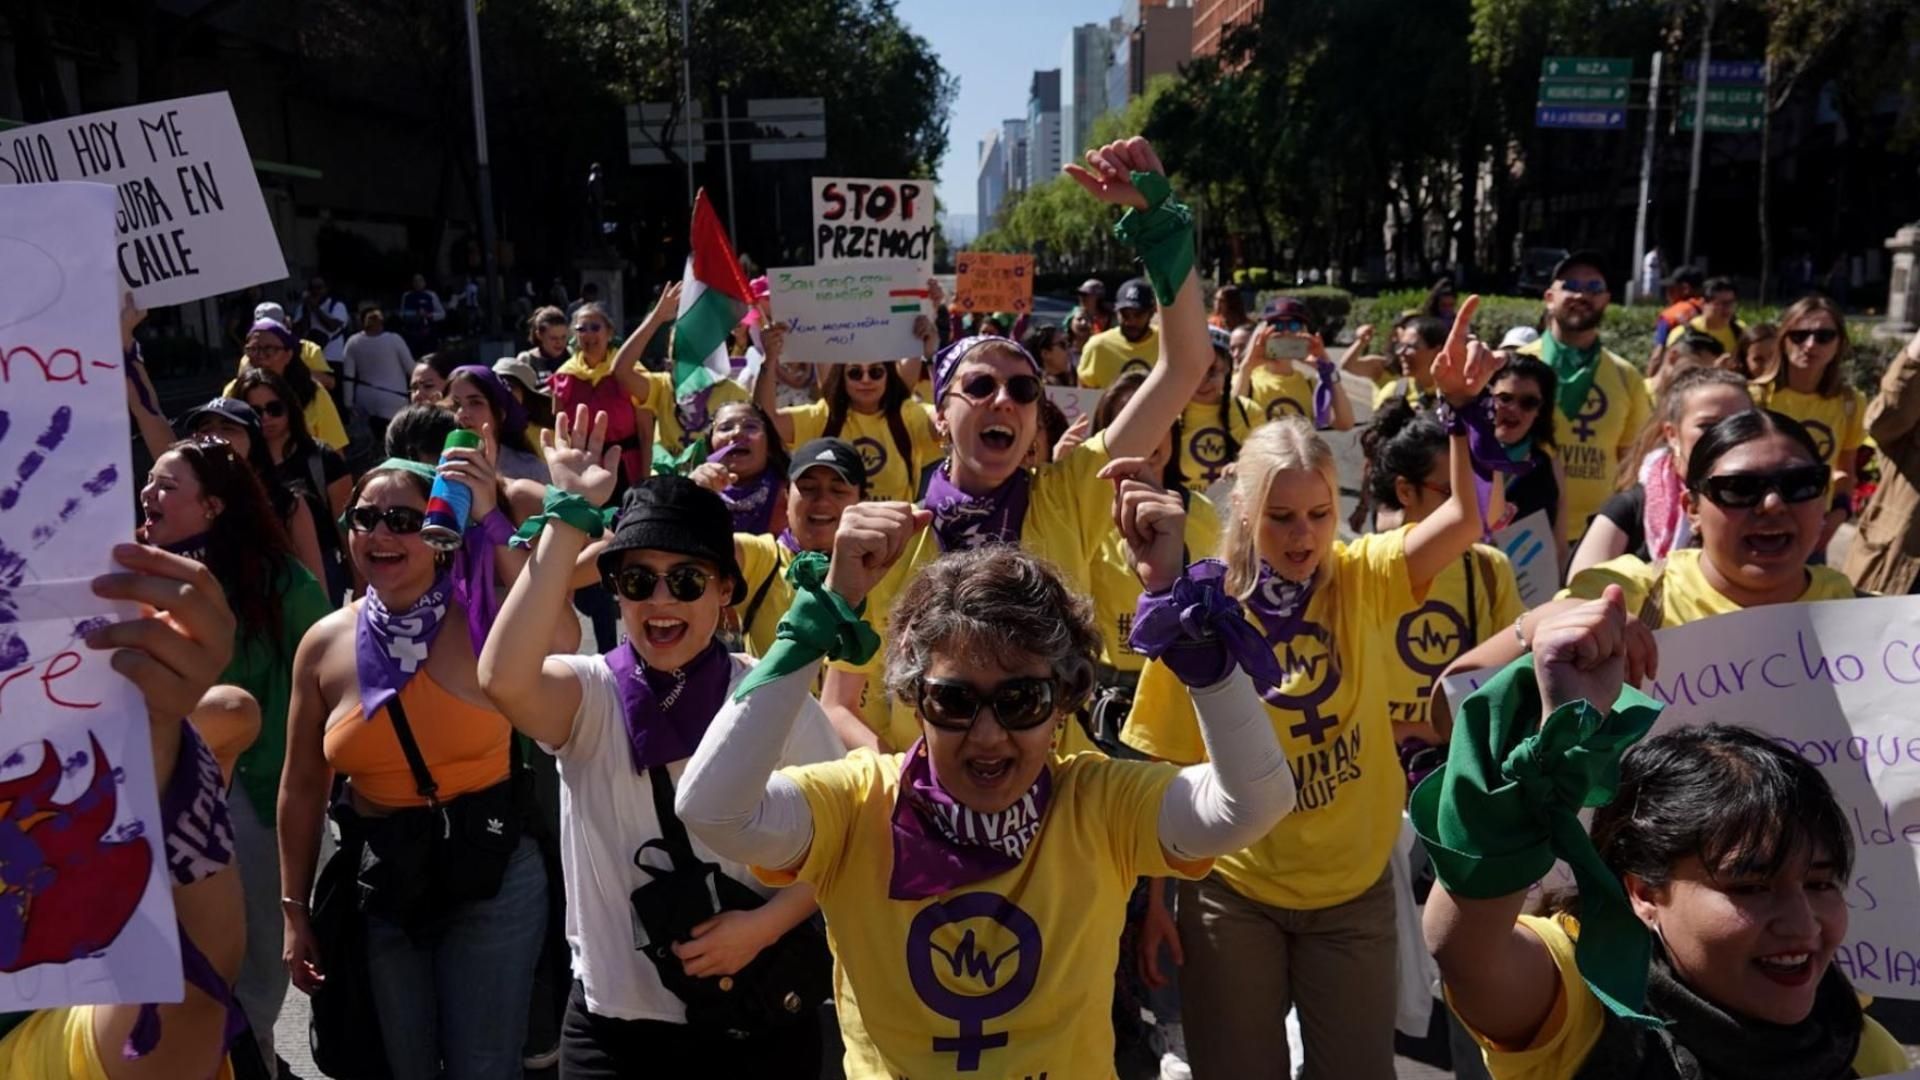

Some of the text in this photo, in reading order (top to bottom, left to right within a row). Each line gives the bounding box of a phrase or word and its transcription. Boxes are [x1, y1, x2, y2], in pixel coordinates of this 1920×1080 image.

[68, 121, 126, 178] HOY
[139, 110, 189, 163] ME
[177, 161, 225, 216] EN
[821, 182, 921, 223] STOP
[117, 229, 200, 289] CALLE
[817, 225, 934, 261] PRZEMOCY
[1834, 941, 1920, 986] ARIA
